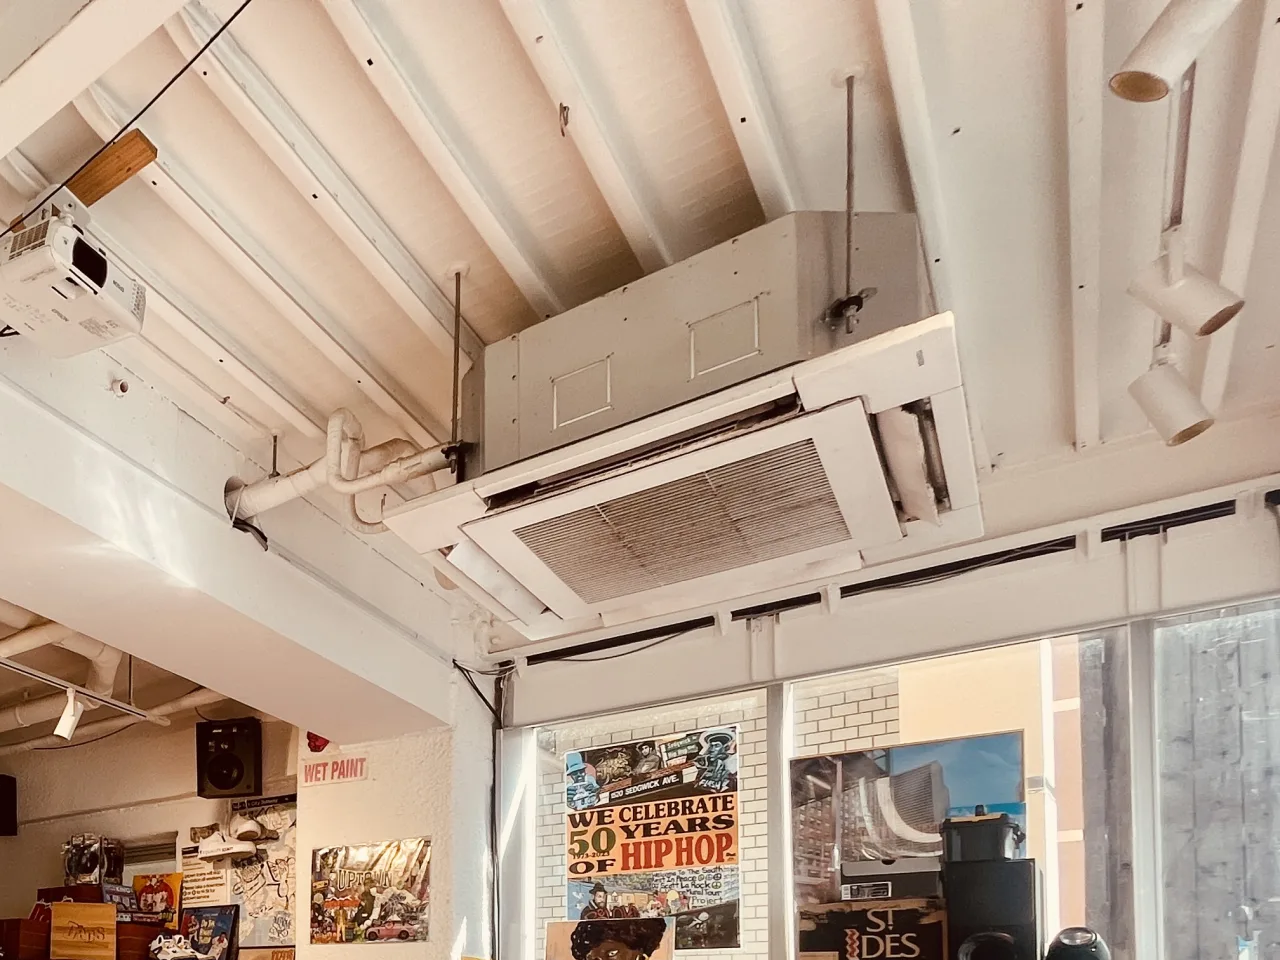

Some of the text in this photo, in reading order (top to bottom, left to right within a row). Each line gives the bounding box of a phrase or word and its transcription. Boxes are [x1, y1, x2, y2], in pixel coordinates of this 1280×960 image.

[303, 757, 367, 783] WET PAINT
[625, 780, 660, 796] SEDGWICK
[568, 794, 735, 829] WE CELEBRATE
[568, 813, 735, 857] 50 YEARS
[569, 832, 733, 875] OF HIP HOP
